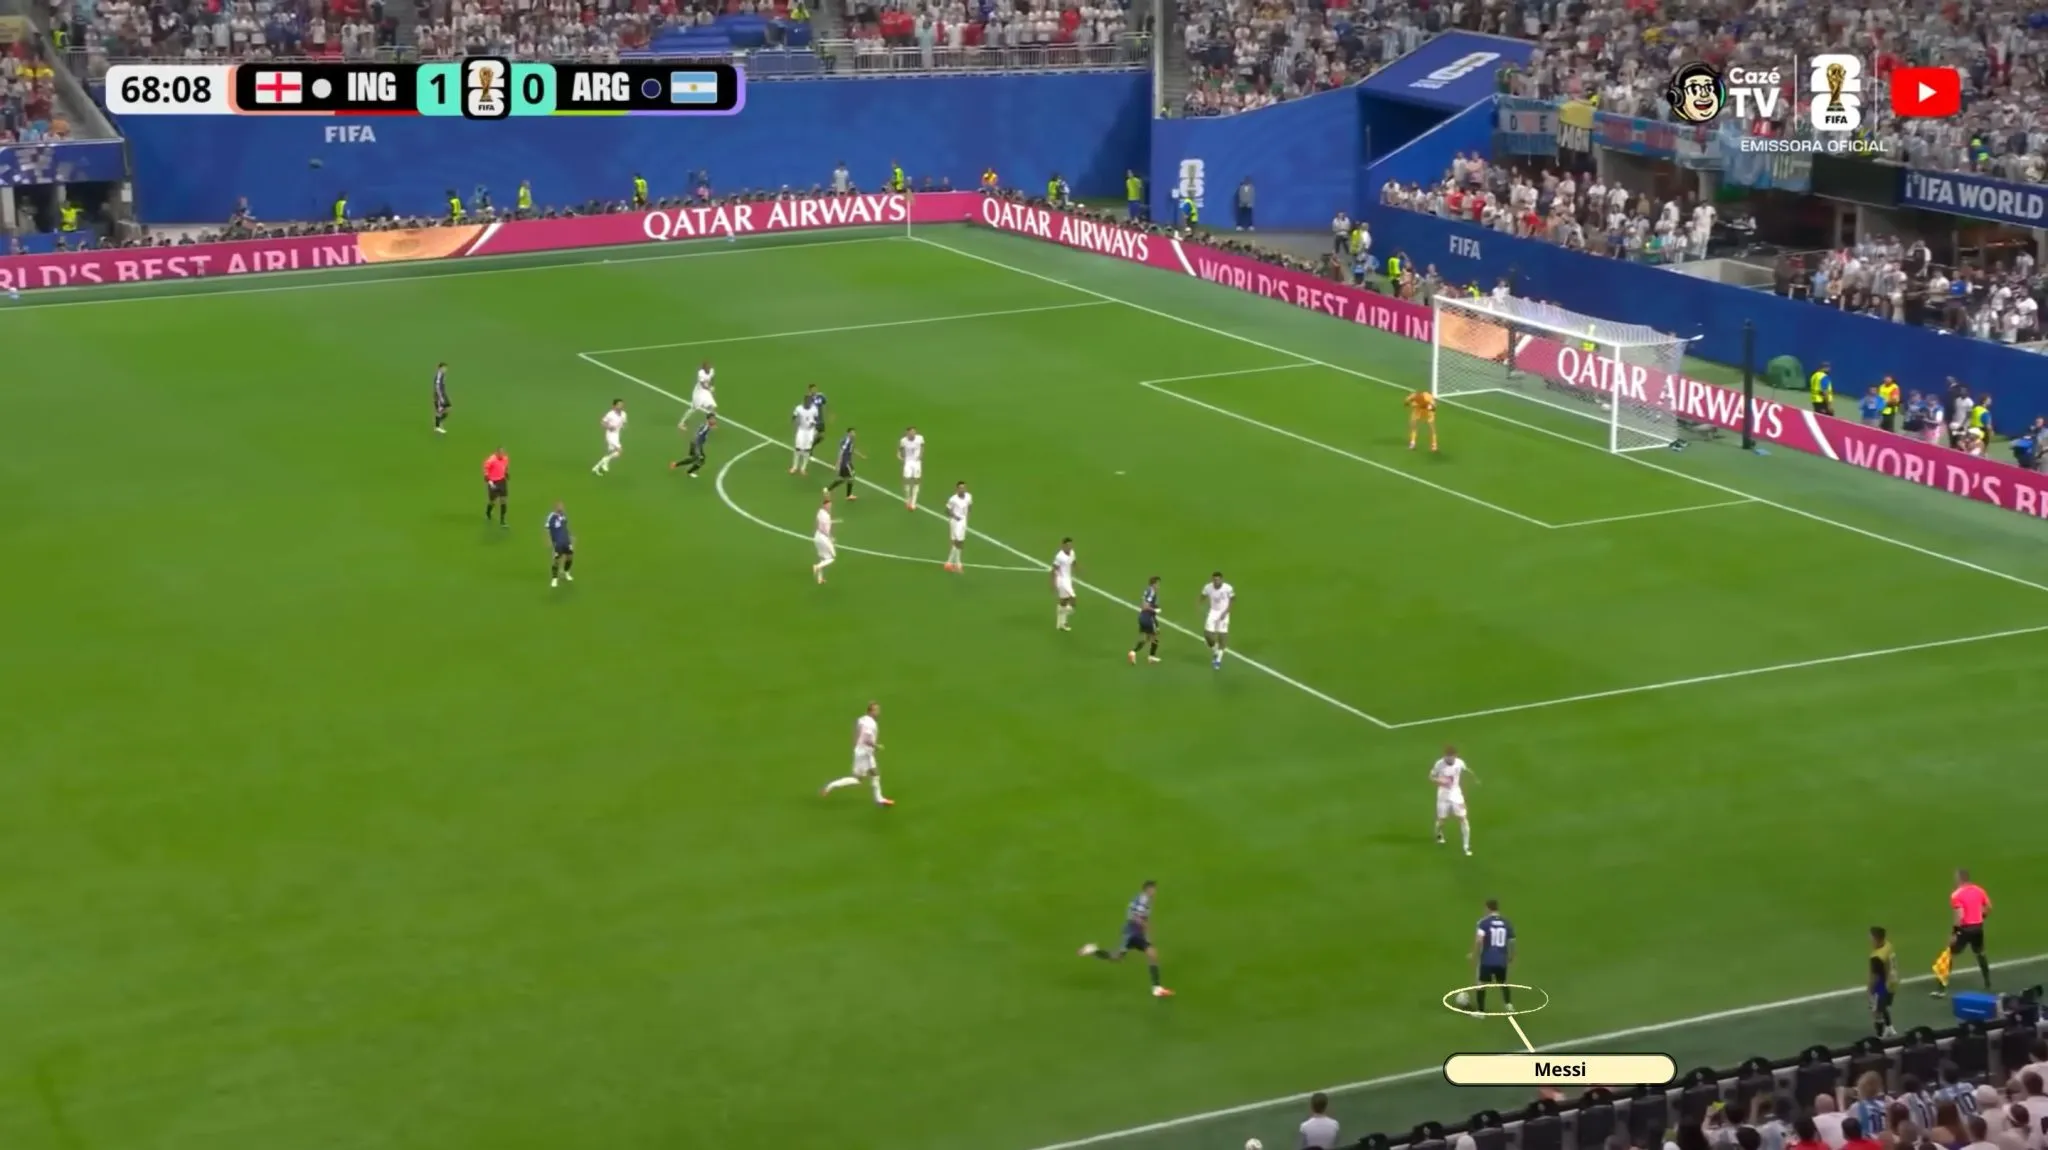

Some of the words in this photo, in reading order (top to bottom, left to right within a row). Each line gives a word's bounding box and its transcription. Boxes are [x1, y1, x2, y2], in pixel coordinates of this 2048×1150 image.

[325, 125, 376, 143] FIFA
[643, 204, 754, 240] QATAR
[767, 194, 906, 228] AIRWAYS
[1957, 182, 2044, 219] WORLD
[982, 197, 1052, 238] QATAR
[1059, 216, 1149, 262] AIRWAYS
[1450, 235, 1481, 260] FIFA
[1355, 302, 1435, 342] AIRLIN
[1557, 347, 1648, 402] QATAR
[1658, 374, 1783, 438] AIRWAYS
[2014, 483, 2048, 520] B
[1489, 927, 1507, 947] 10
